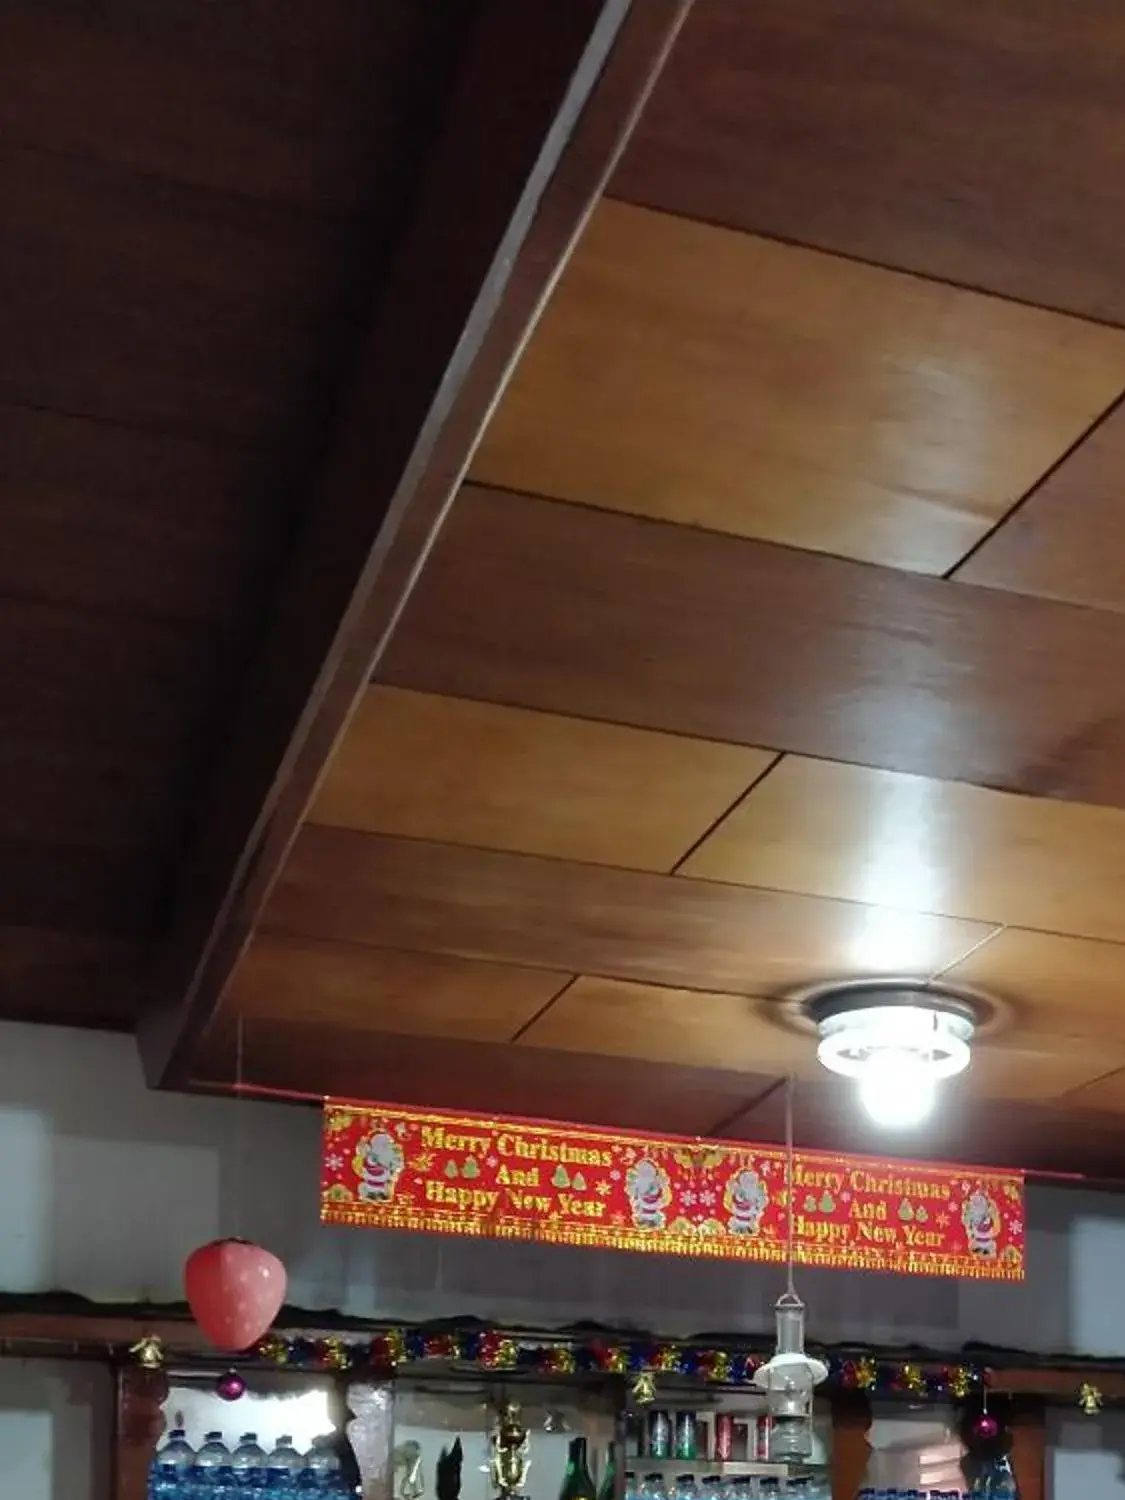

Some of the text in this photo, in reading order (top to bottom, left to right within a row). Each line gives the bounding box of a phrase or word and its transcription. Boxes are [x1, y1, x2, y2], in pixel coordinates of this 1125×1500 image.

[420, 1126, 612, 1167] Merry Christmas
[496, 1163, 540, 1187] And
[850, 1169, 951, 1199] Christmas
[425, 1180, 606, 1217] Happy New Year
[849, 1197, 887, 1221] And
[855, 1220, 897, 1245] New
[902, 1224, 946, 1247] Year
